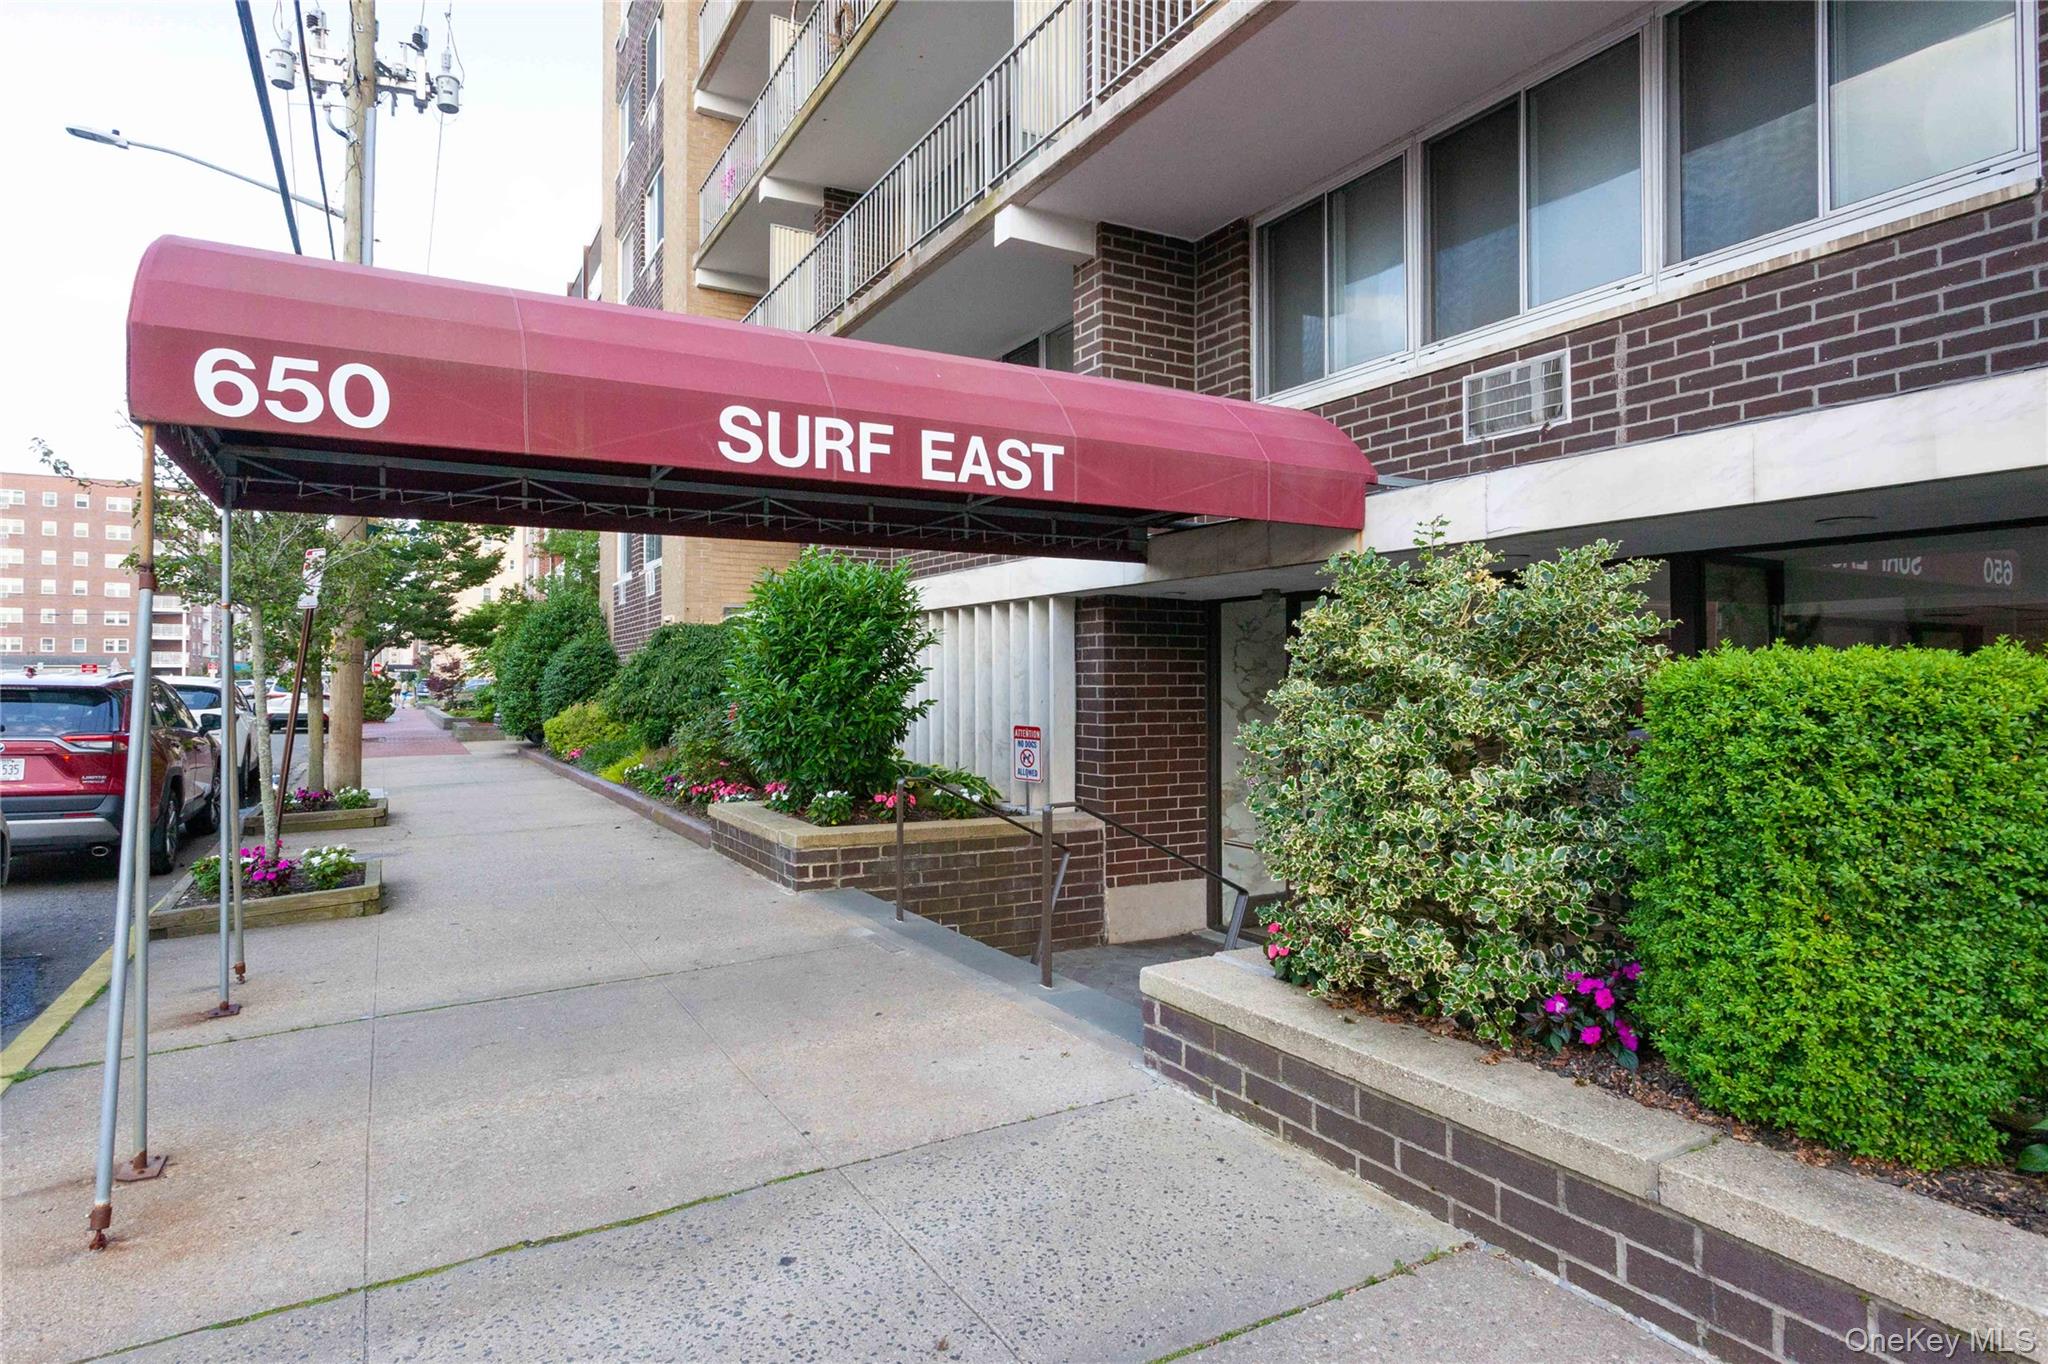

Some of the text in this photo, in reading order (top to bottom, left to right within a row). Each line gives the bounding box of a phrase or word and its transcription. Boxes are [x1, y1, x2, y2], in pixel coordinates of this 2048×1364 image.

[193, 347, 1065, 492] 650 SURF EAST
[1015, 729, 1041, 738] ATTENTION
[1017, 740, 1038, 749] NO DOGS
[1017, 768, 1039, 777] ALLOWED
